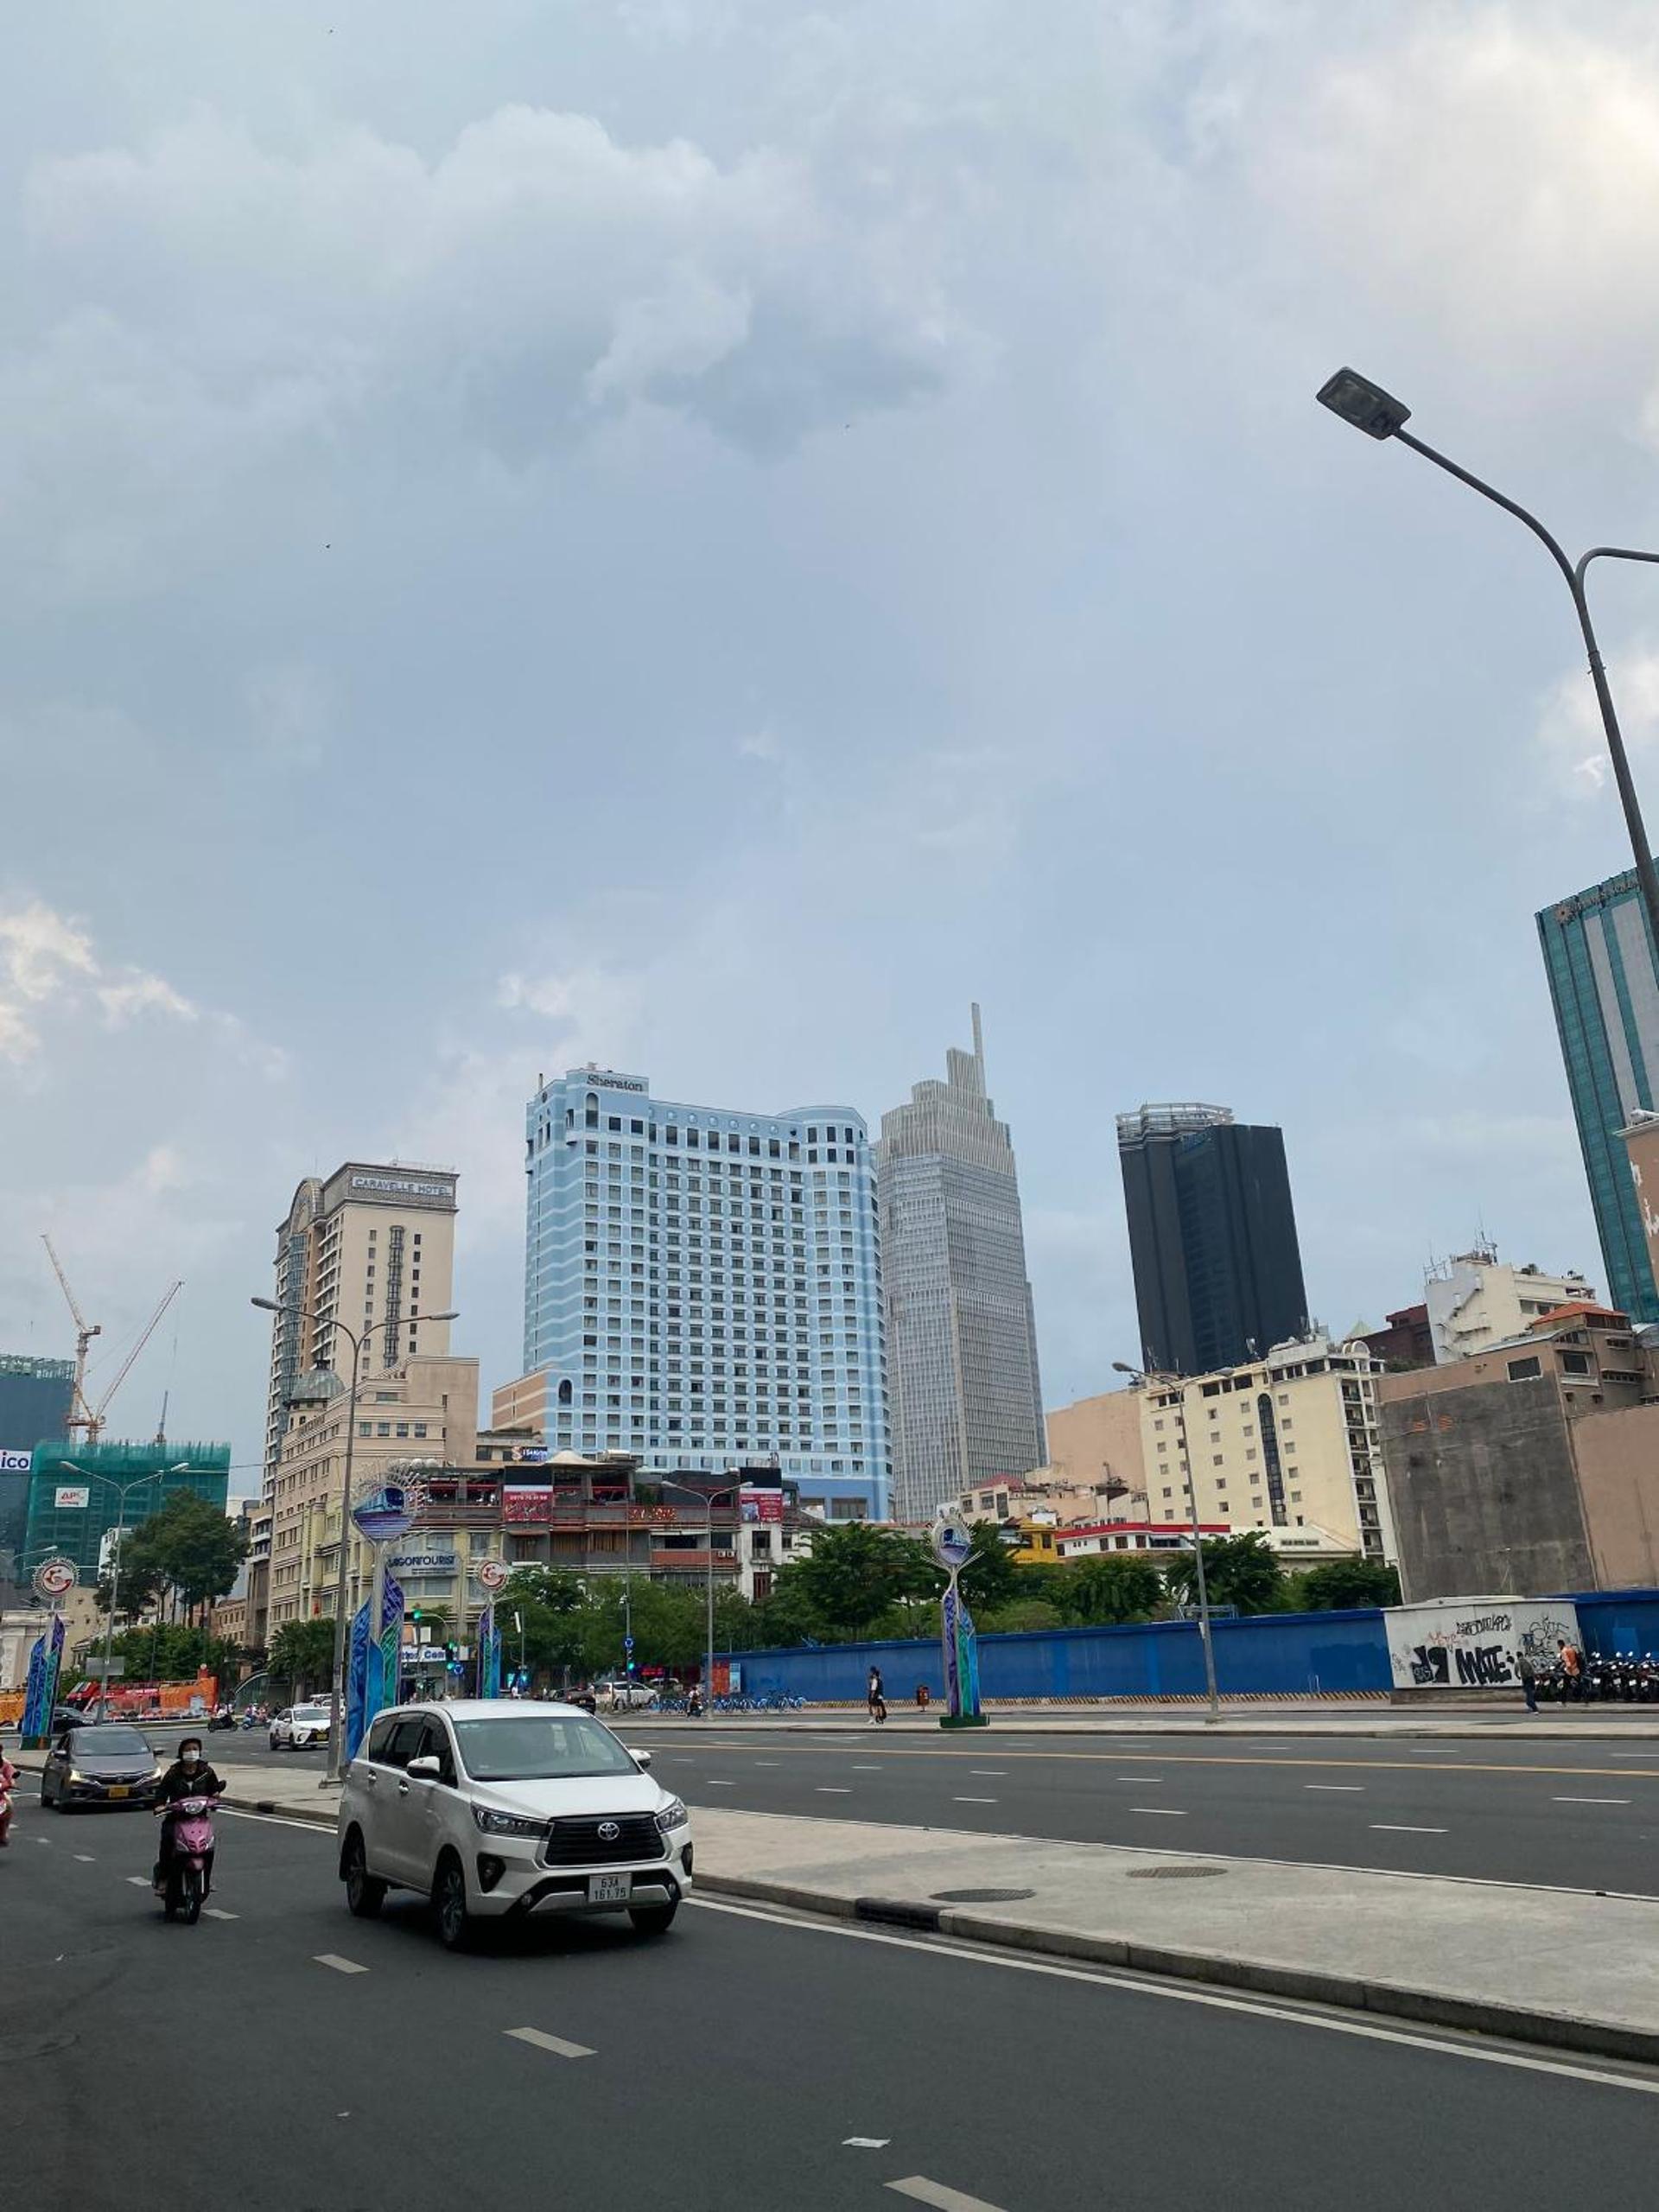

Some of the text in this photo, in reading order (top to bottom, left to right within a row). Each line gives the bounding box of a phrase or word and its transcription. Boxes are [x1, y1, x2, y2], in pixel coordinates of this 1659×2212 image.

[587, 1074, 643, 1091] Sheraton
[355, 1179, 448, 1195] CARAVELLE HOTEL
[1, 1452, 29, 1469] ico
